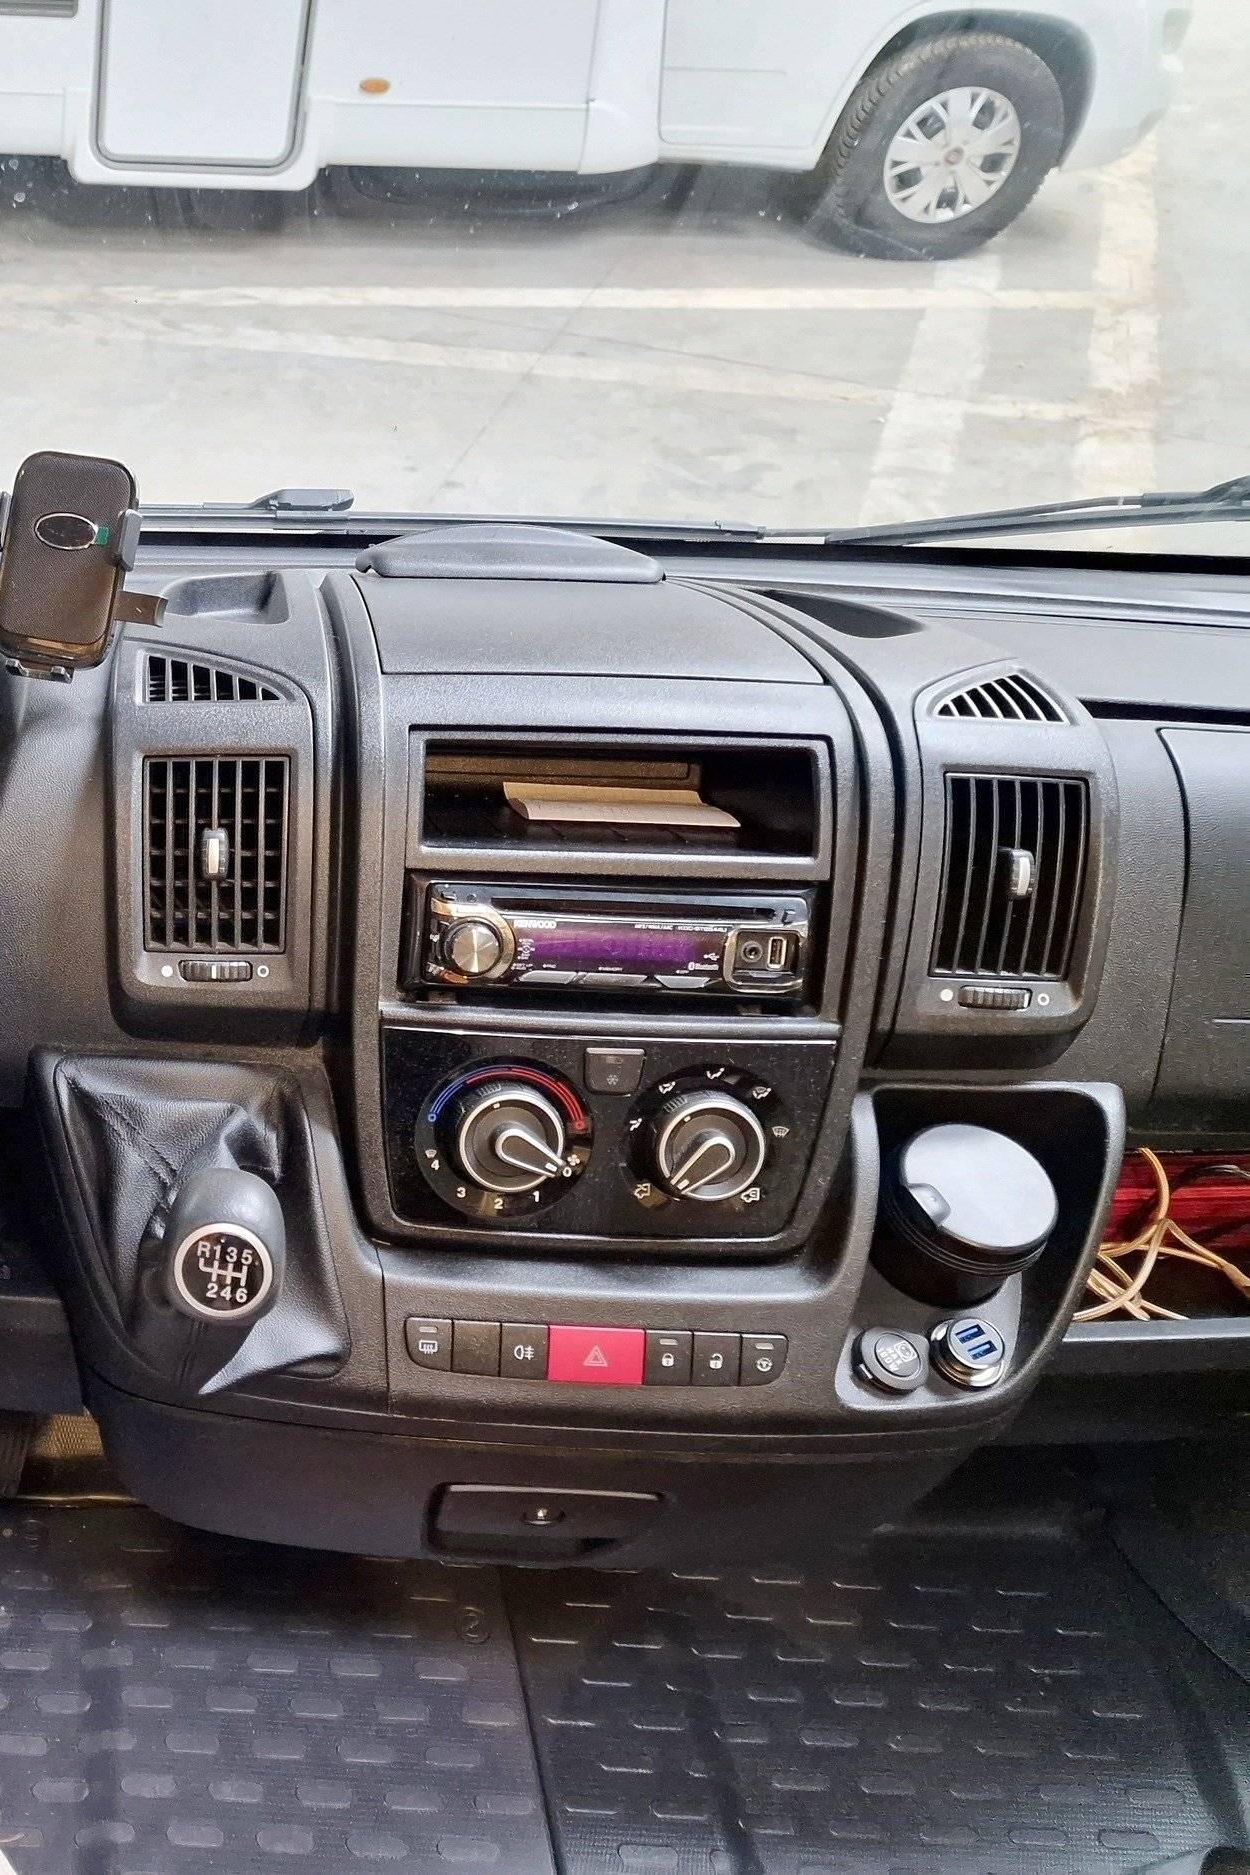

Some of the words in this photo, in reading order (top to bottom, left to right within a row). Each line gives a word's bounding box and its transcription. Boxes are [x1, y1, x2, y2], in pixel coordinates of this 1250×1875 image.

[513, 919, 557, 930] KENWOOD
[431, 1159, 440, 1171] 4
[562, 1166, 572, 1177] 0
[456, 1187, 466, 1198] 3
[532, 1190, 540, 1202] 1
[494, 1199, 504, 1210] 2
[197, 1241, 210, 1259] R
[213, 1245, 221, 1260] 1
[225, 1246, 237, 1262] 3
[241, 1249, 253, 1265] 5
[205, 1283, 217, 1298] 2
[220, 1286, 233, 1301] 4
[235, 1288, 248, 1303] 6
